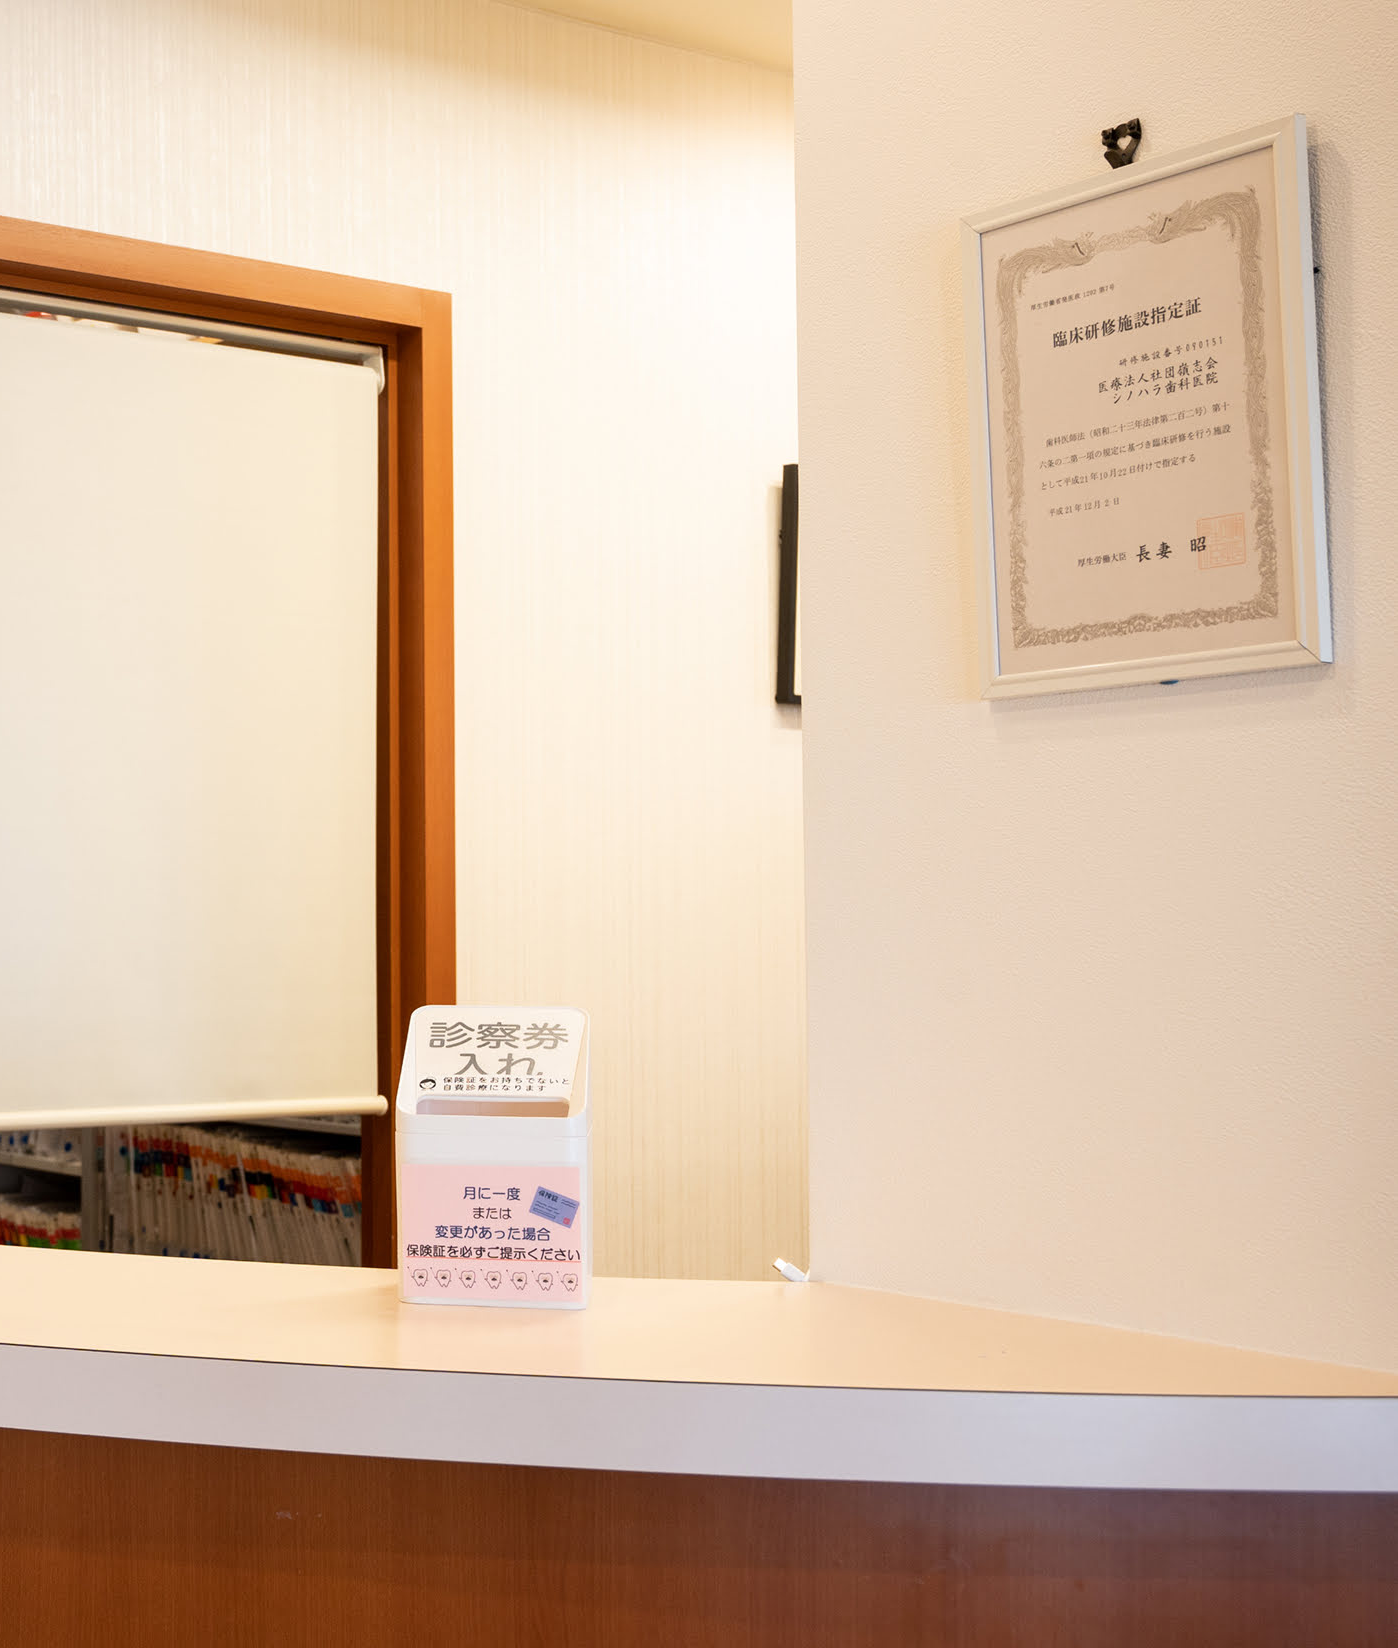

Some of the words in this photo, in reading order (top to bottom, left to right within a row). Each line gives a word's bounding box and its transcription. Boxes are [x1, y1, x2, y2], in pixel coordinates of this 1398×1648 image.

[1053, 297, 1202, 349] 臨床研修施設指定証
[1098, 356, 1218, 393] 医療法人社団嶺志会
[1113, 371, 1219, 404] シノハラ歯科医院
[1077, 552, 1127, 568] 厚生労働大臣
[1190, 536, 1208, 554] 昭
[429, 1021, 569, 1050] 診察券
[443, 1076, 570, 1085] 保険証をお持ちでないと
[443, 1084, 546, 1092] 自費診療になります
[462, 1186, 521, 1201] 月に一度
[472, 1206, 513, 1221] または
[435, 1225, 551, 1242] 変更があった場合
[406, 1244, 581, 1262] 保険証を必ずご提示ください
